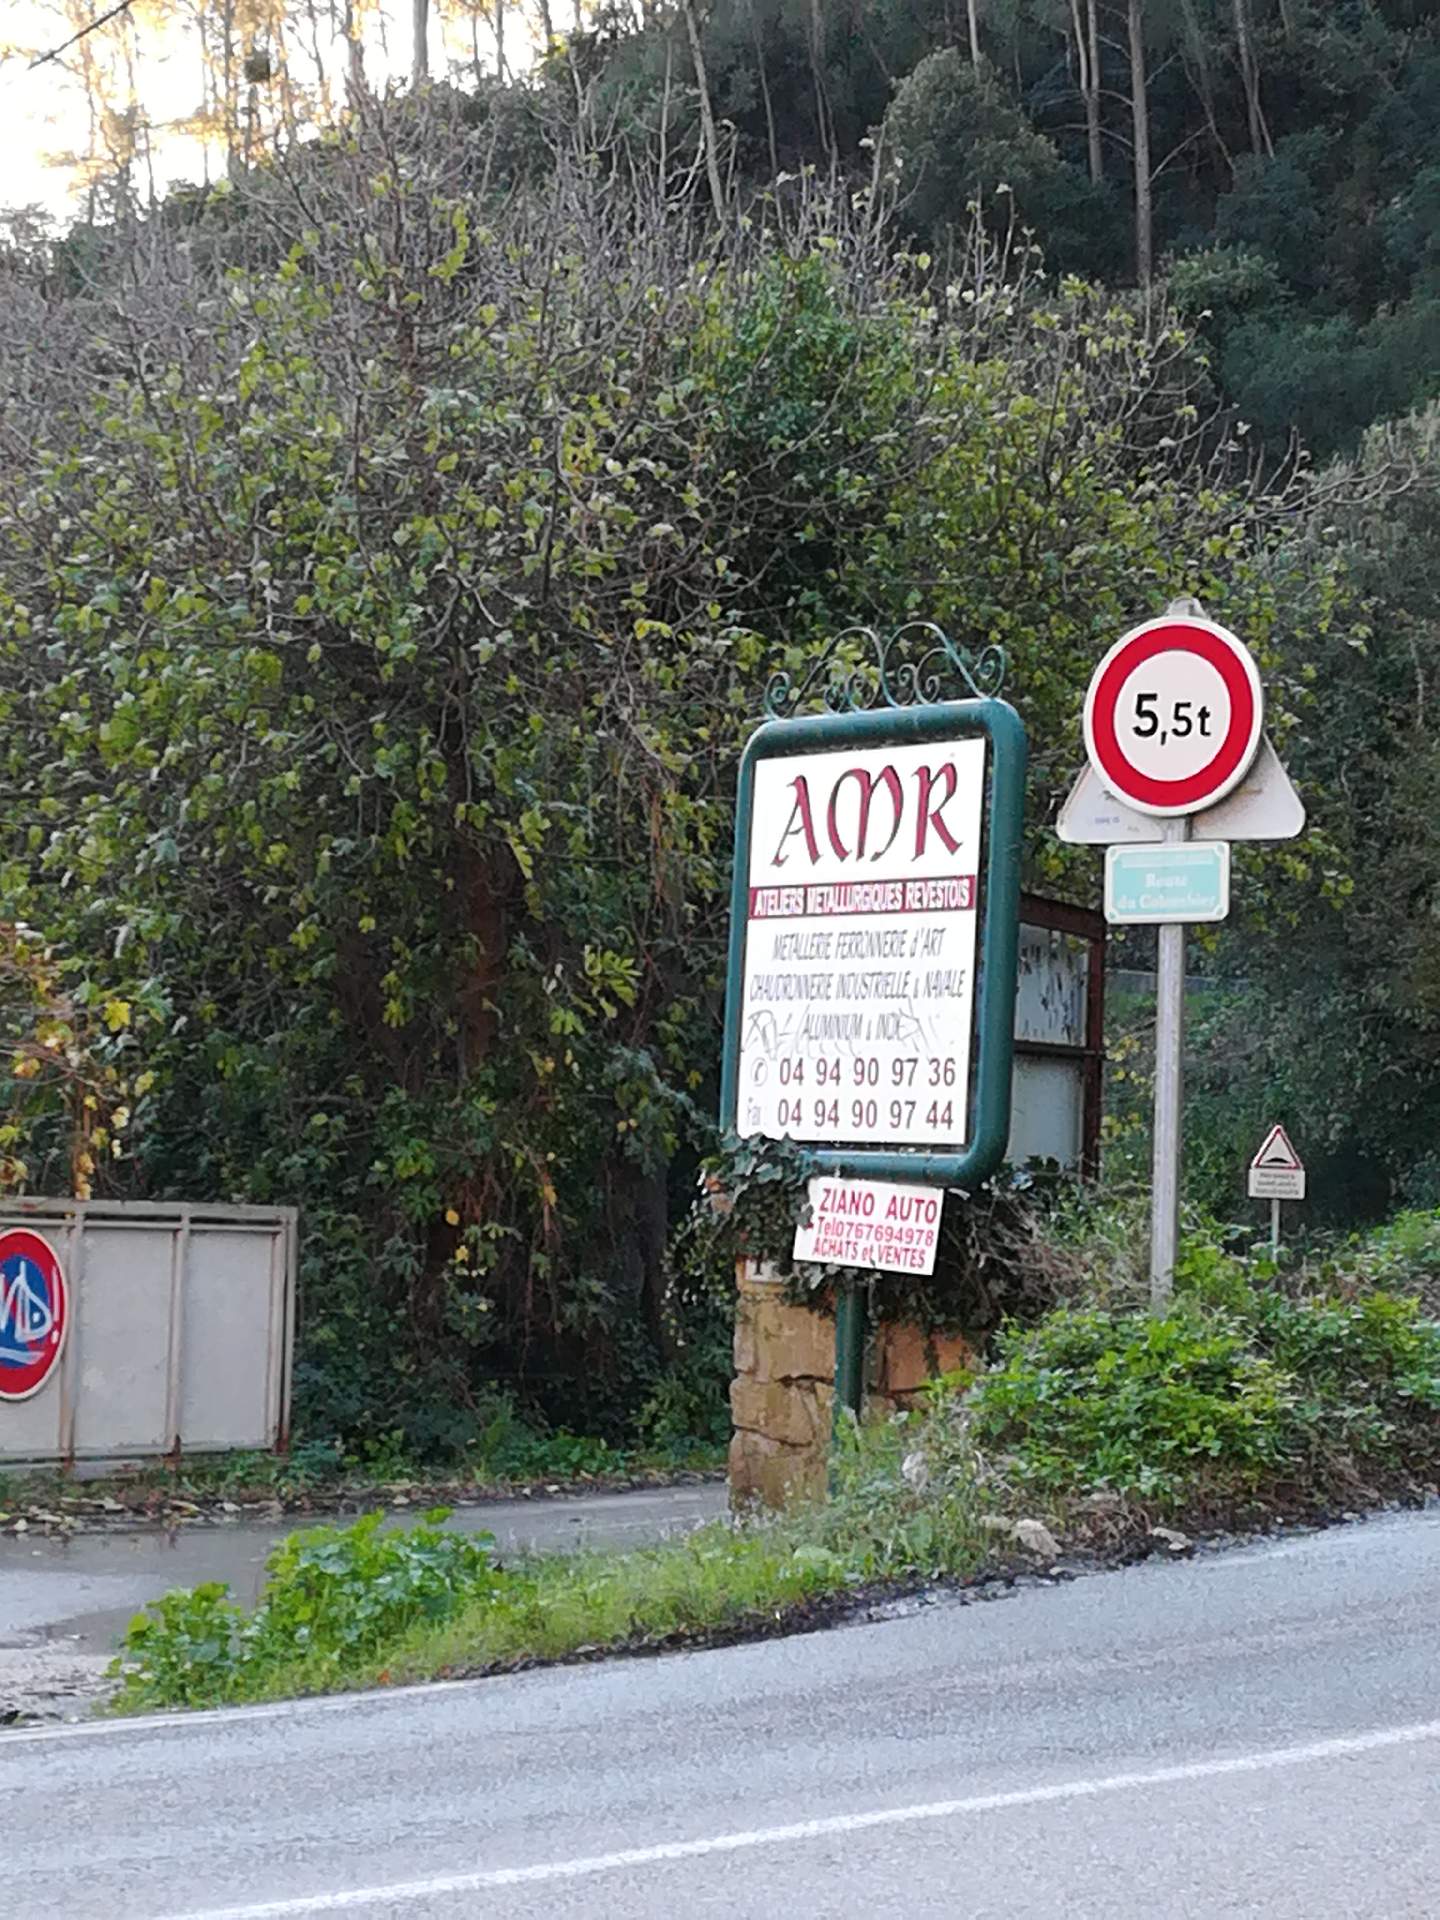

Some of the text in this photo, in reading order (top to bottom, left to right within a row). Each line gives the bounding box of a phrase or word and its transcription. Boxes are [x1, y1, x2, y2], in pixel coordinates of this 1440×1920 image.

[770, 762, 963, 867] AMR
[754, 888, 804, 916] ATELIERS
[779, 1057, 956, 1087] 04 94 90 97 36
[777, 1098, 803, 1127] 04
[814, 1098, 840, 1127] 94
[851, 1099, 878, 1128] 90
[889, 1099, 917, 1129] 97
[925, 1100, 953, 1130] 44
[818, 1187, 937, 1224] ZIANO AUTO
[812, 1237, 858, 1261] ACHATS
[878, 1243, 926, 1269] VENTES
